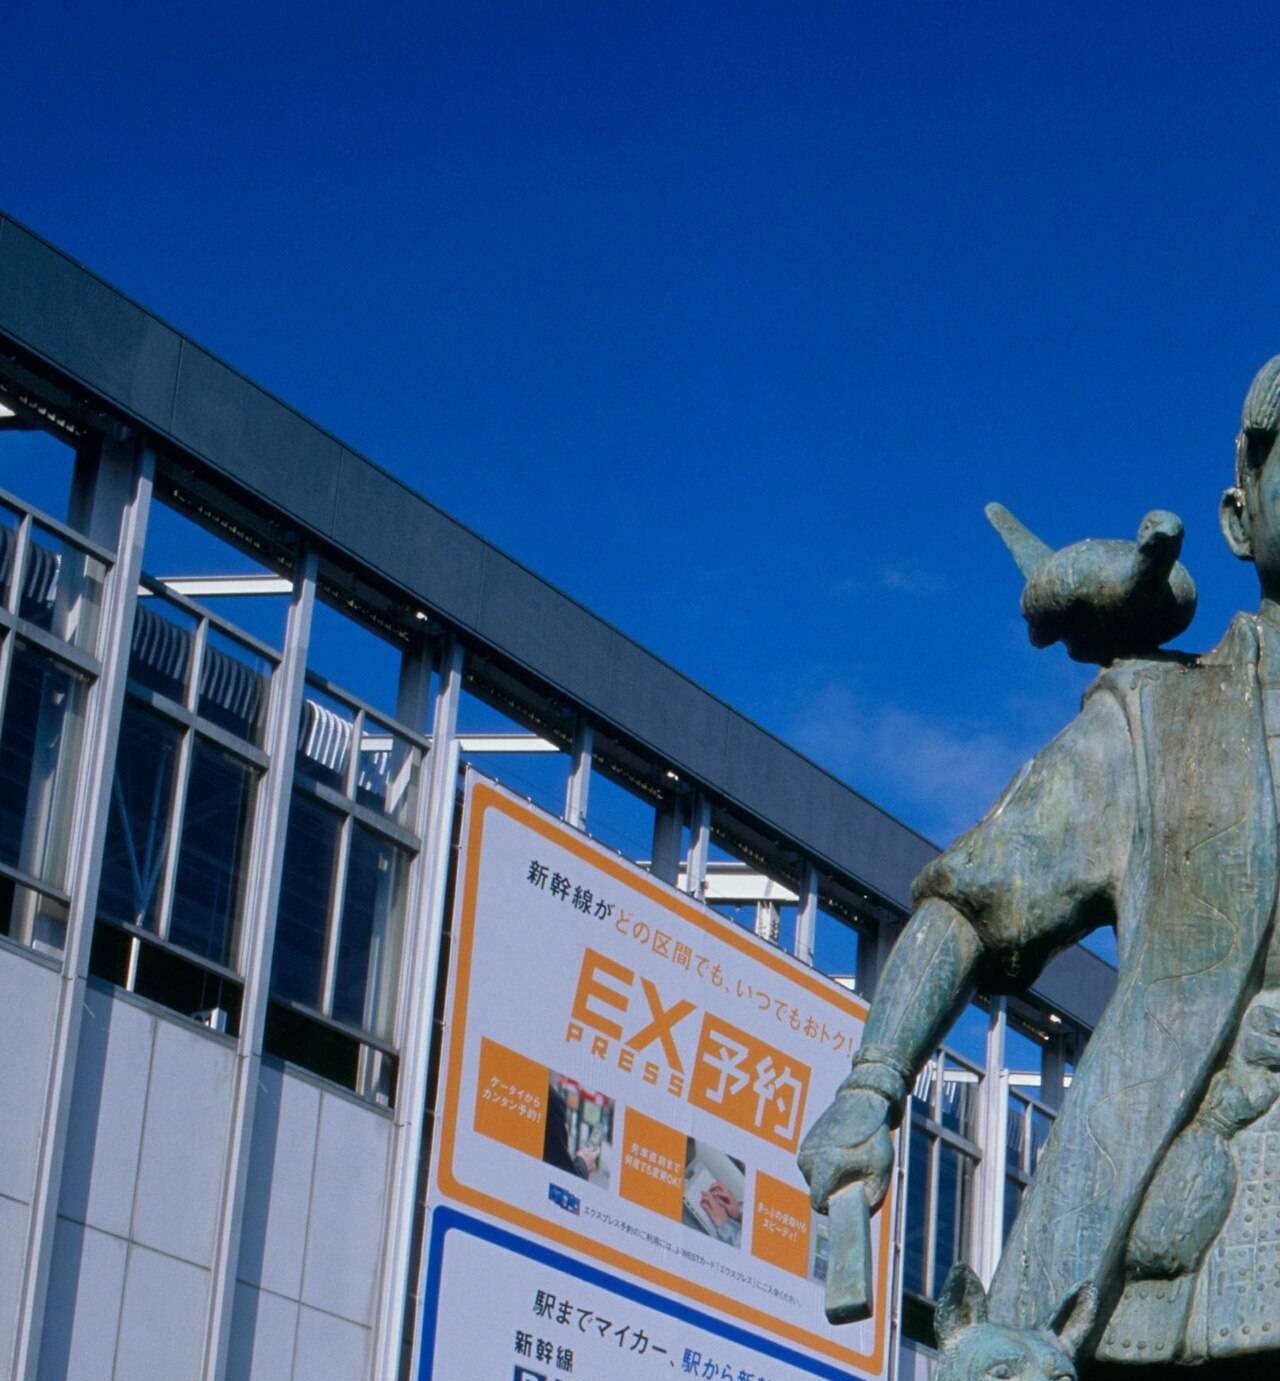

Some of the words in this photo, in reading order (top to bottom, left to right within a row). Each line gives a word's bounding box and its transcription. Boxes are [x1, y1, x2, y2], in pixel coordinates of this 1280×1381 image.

[565, 1021, 686, 1099] PRESS
[571, 947, 697, 1077] EX
[702, 1029, 804, 1142] 予約
[514, 1329, 574, 1373] 新幹線
